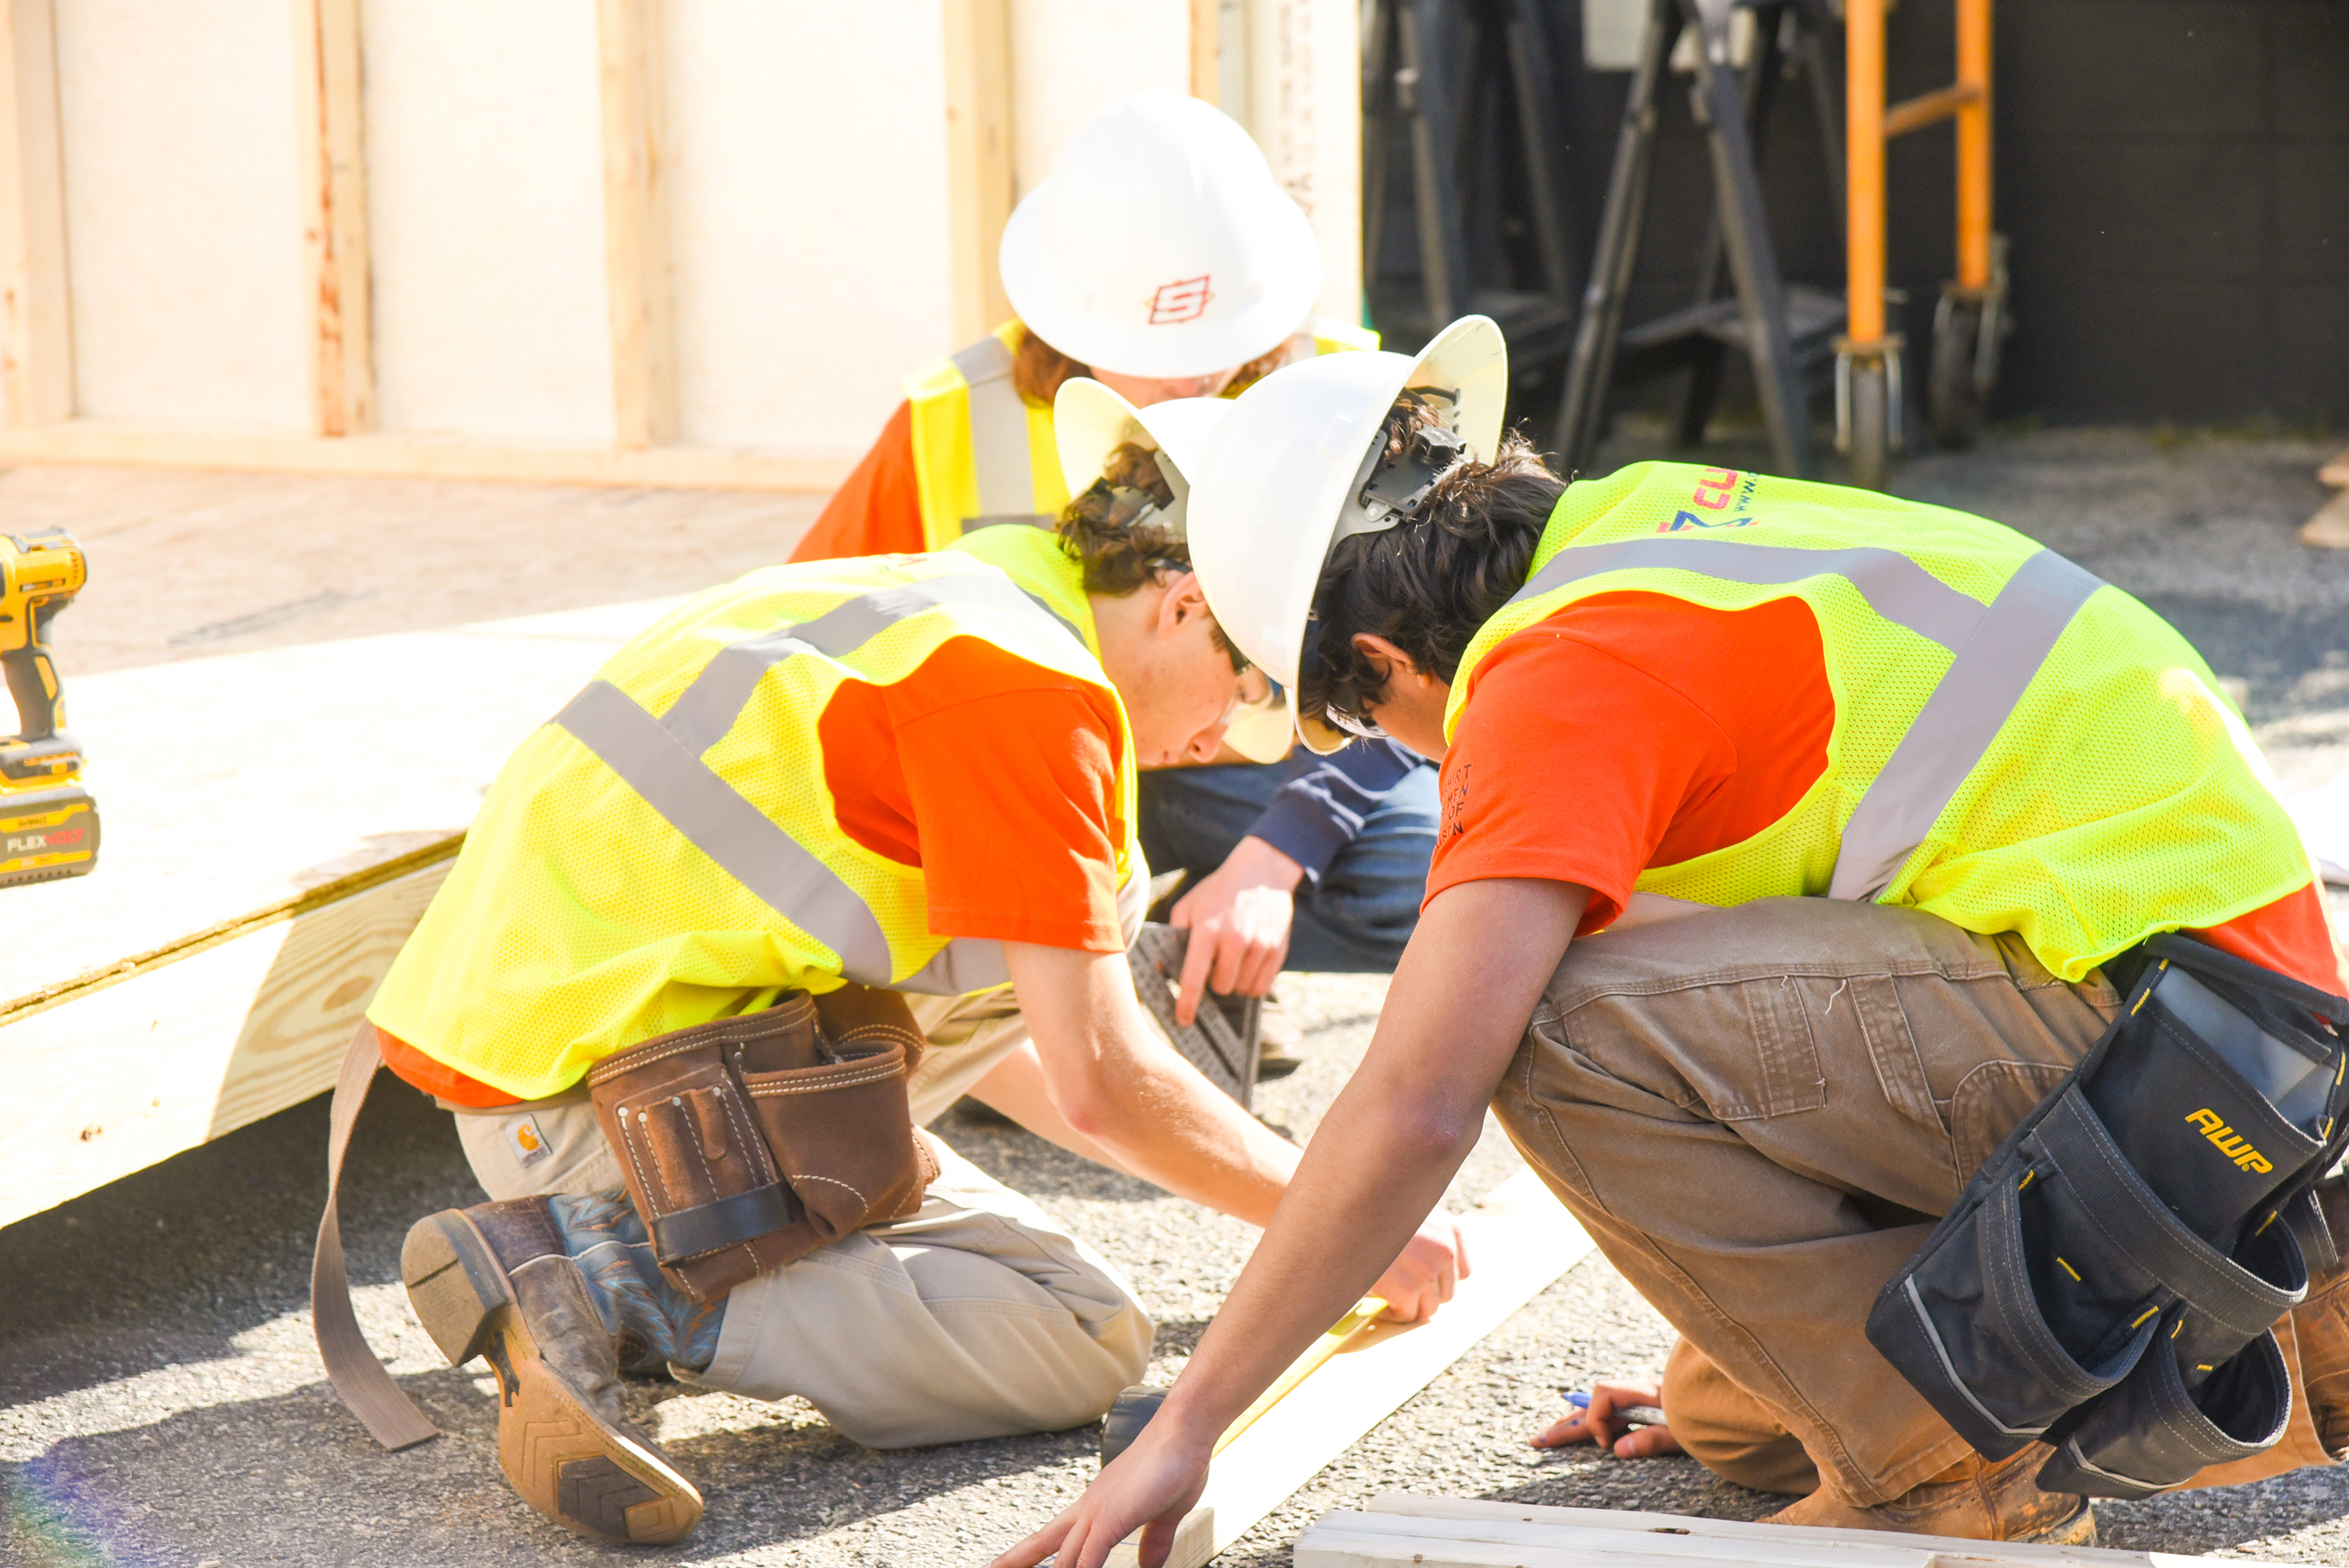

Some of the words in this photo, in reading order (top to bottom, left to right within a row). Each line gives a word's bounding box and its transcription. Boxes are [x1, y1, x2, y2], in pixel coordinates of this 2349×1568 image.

[1447, 782, 1469, 809] MEN
[1448, 802, 1465, 820] OF
[7, 827, 85, 853] FLEXVOLT
[2184, 1107, 2273, 1174] AWP
